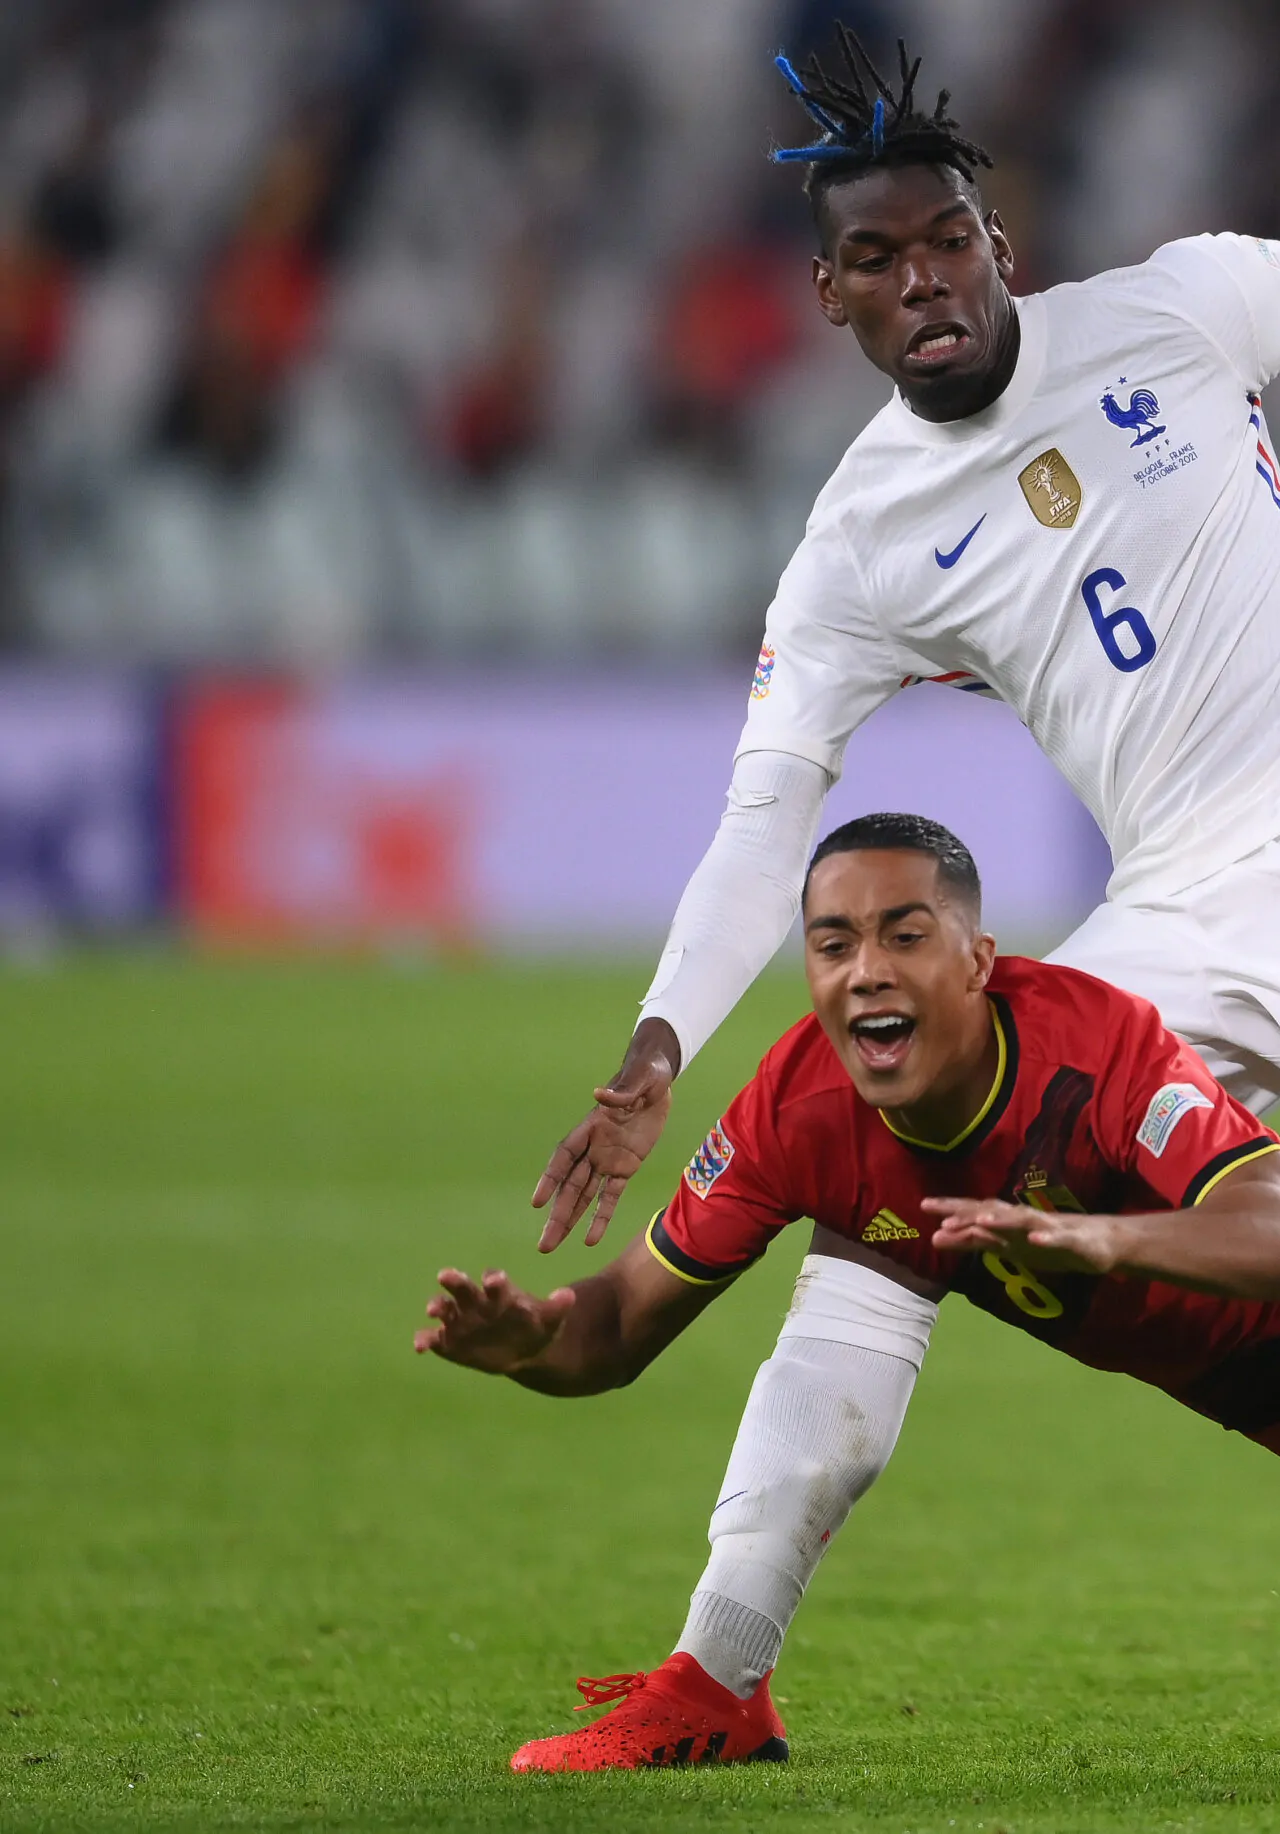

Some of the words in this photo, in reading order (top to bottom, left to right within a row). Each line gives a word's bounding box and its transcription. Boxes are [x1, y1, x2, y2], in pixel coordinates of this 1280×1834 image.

[1133, 459, 1164, 482] BELGIQUE
[1169, 442, 1195, 460] FRANCE
[1140, 480, 1146, 489] 7
[1147, 462, 1179, 485] OCTOBRE
[1178, 451, 1198, 467] 2021
[1049, 496, 1071, 516] FIFA
[1081, 567, 1157, 673] 6
[1146, 1092, 1184, 1147] FOUNDA
[862, 1226, 920, 1243] adidas
[982, 1250, 1064, 1319] 8
